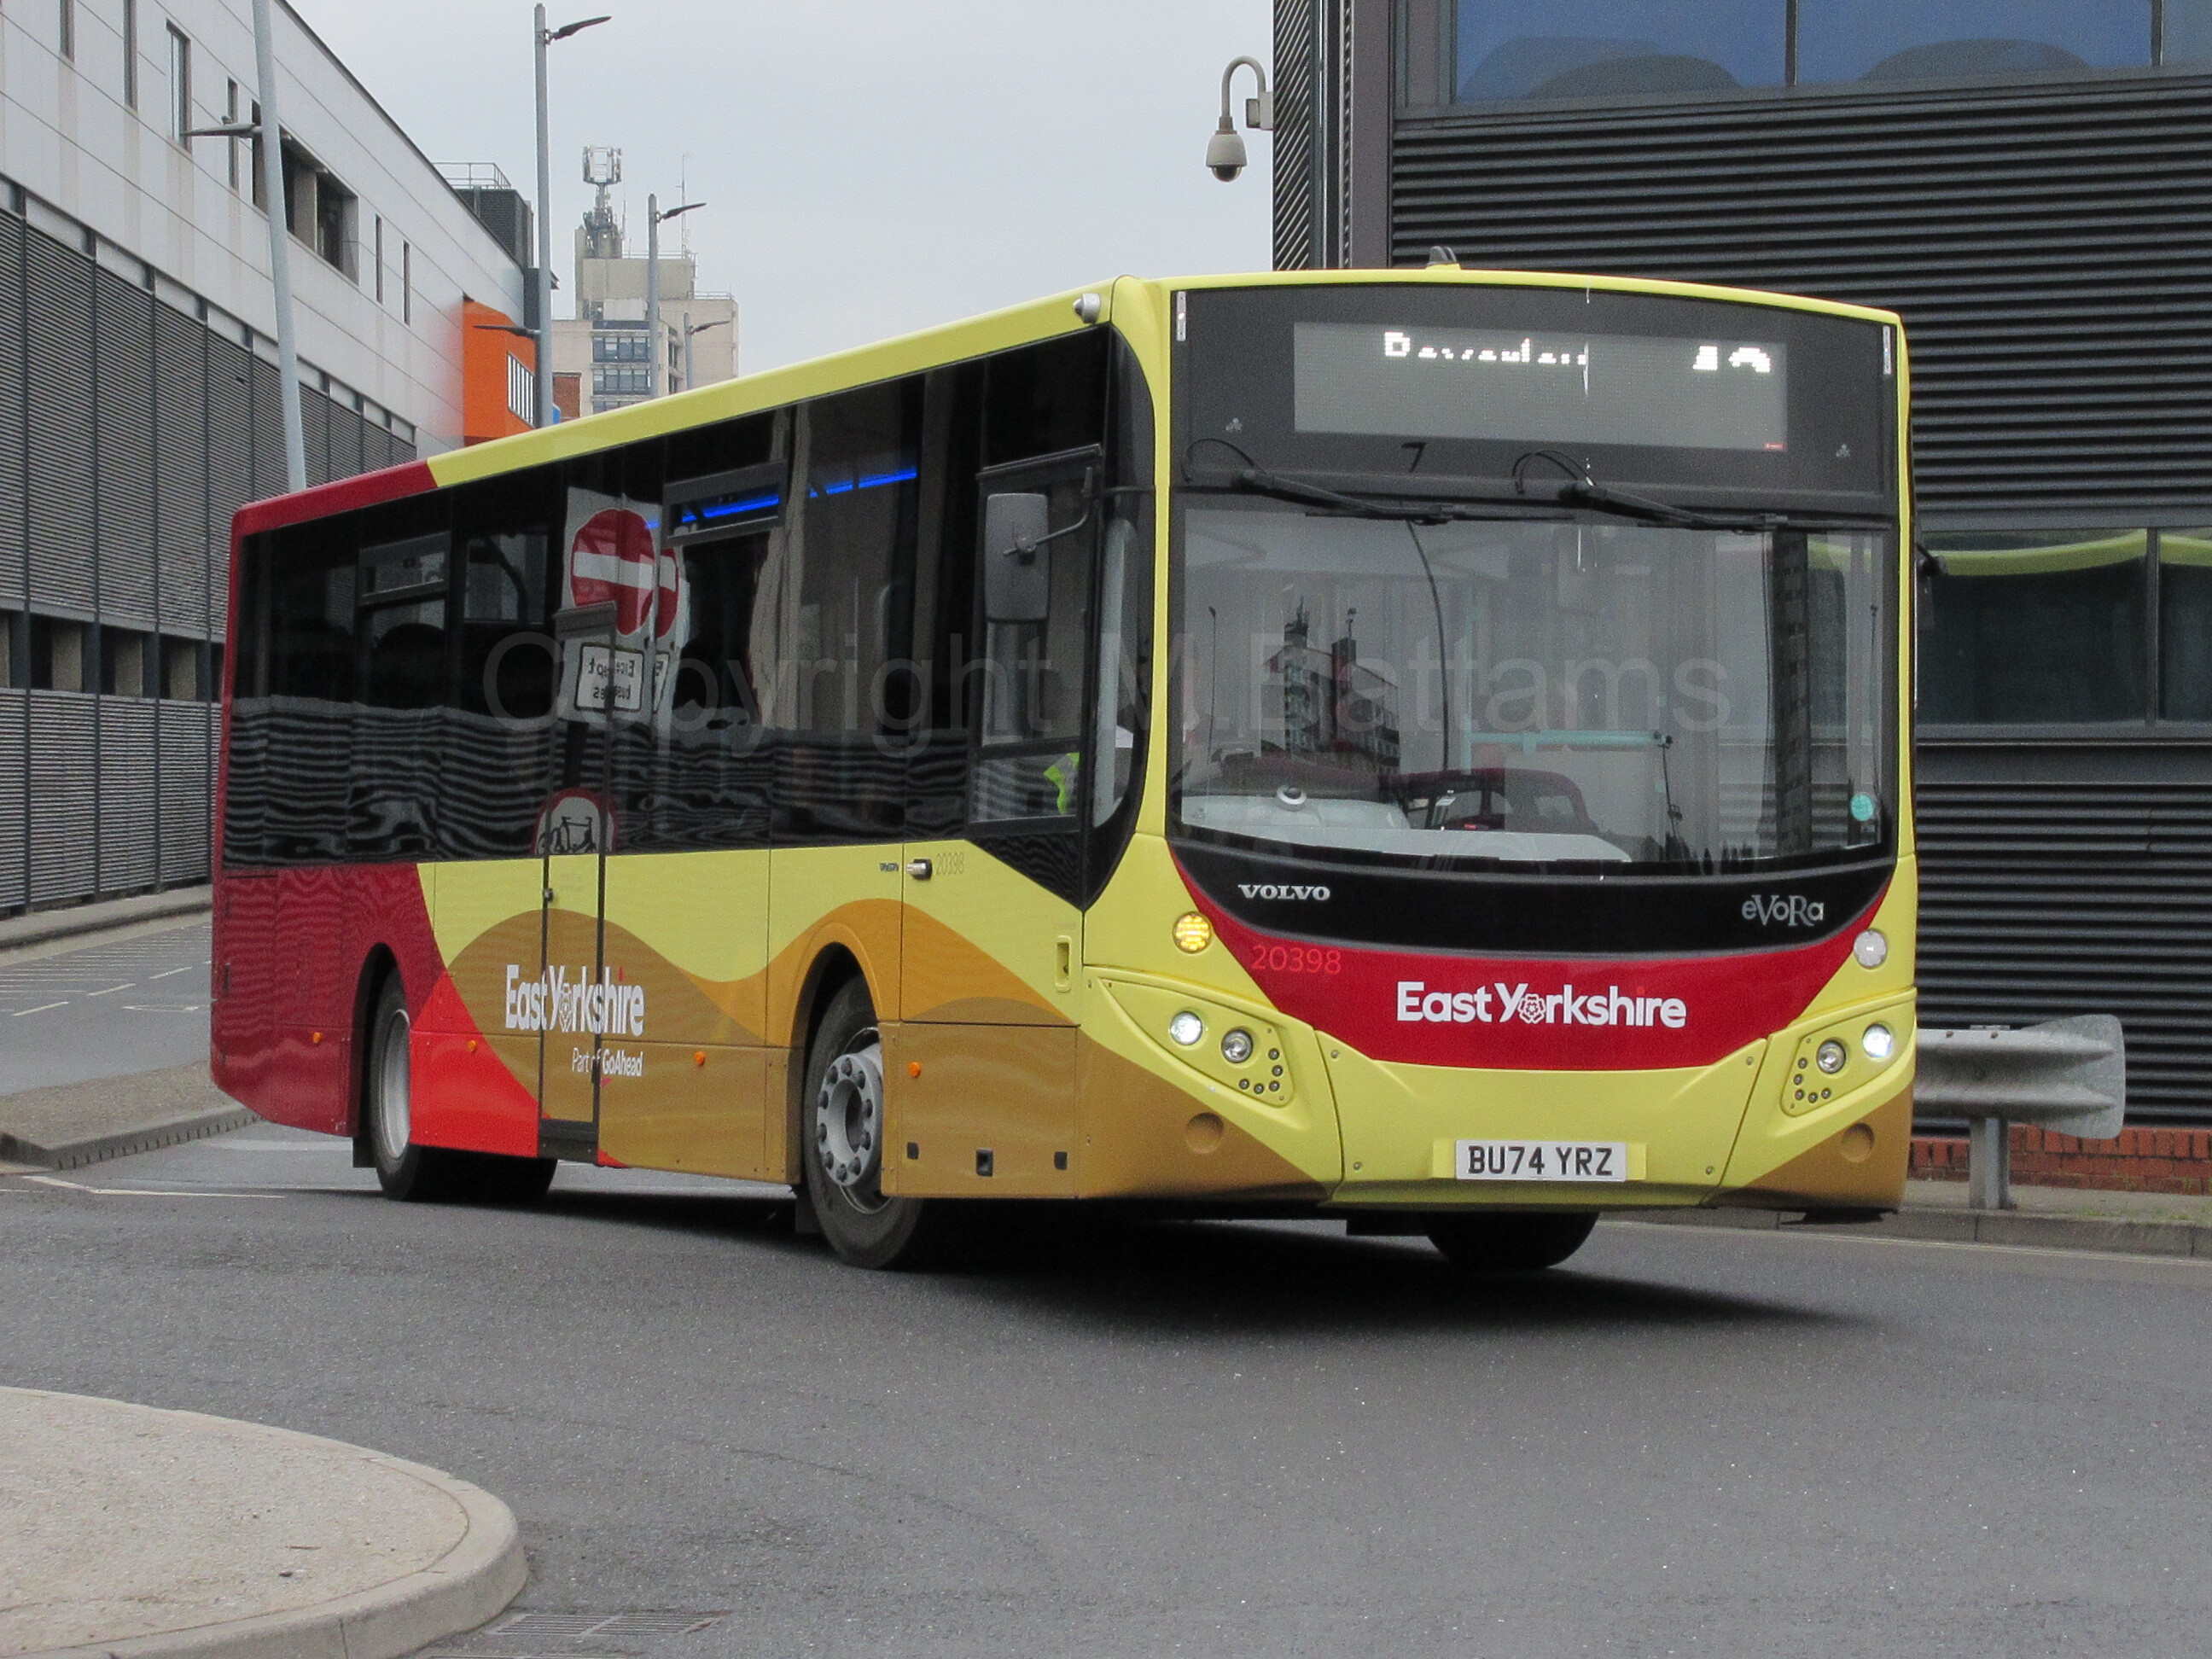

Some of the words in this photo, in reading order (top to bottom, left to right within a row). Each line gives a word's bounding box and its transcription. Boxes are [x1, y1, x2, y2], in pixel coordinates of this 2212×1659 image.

[936, 852, 964, 876] 20398
[1237, 884, 1330, 901] VOLVO
[1251, 944, 1342, 975] 20398
[572, 1047, 590, 1073] Part
[1468, 1145, 1545, 1174] BU74
[1556, 1147, 1613, 1176] YRZ
